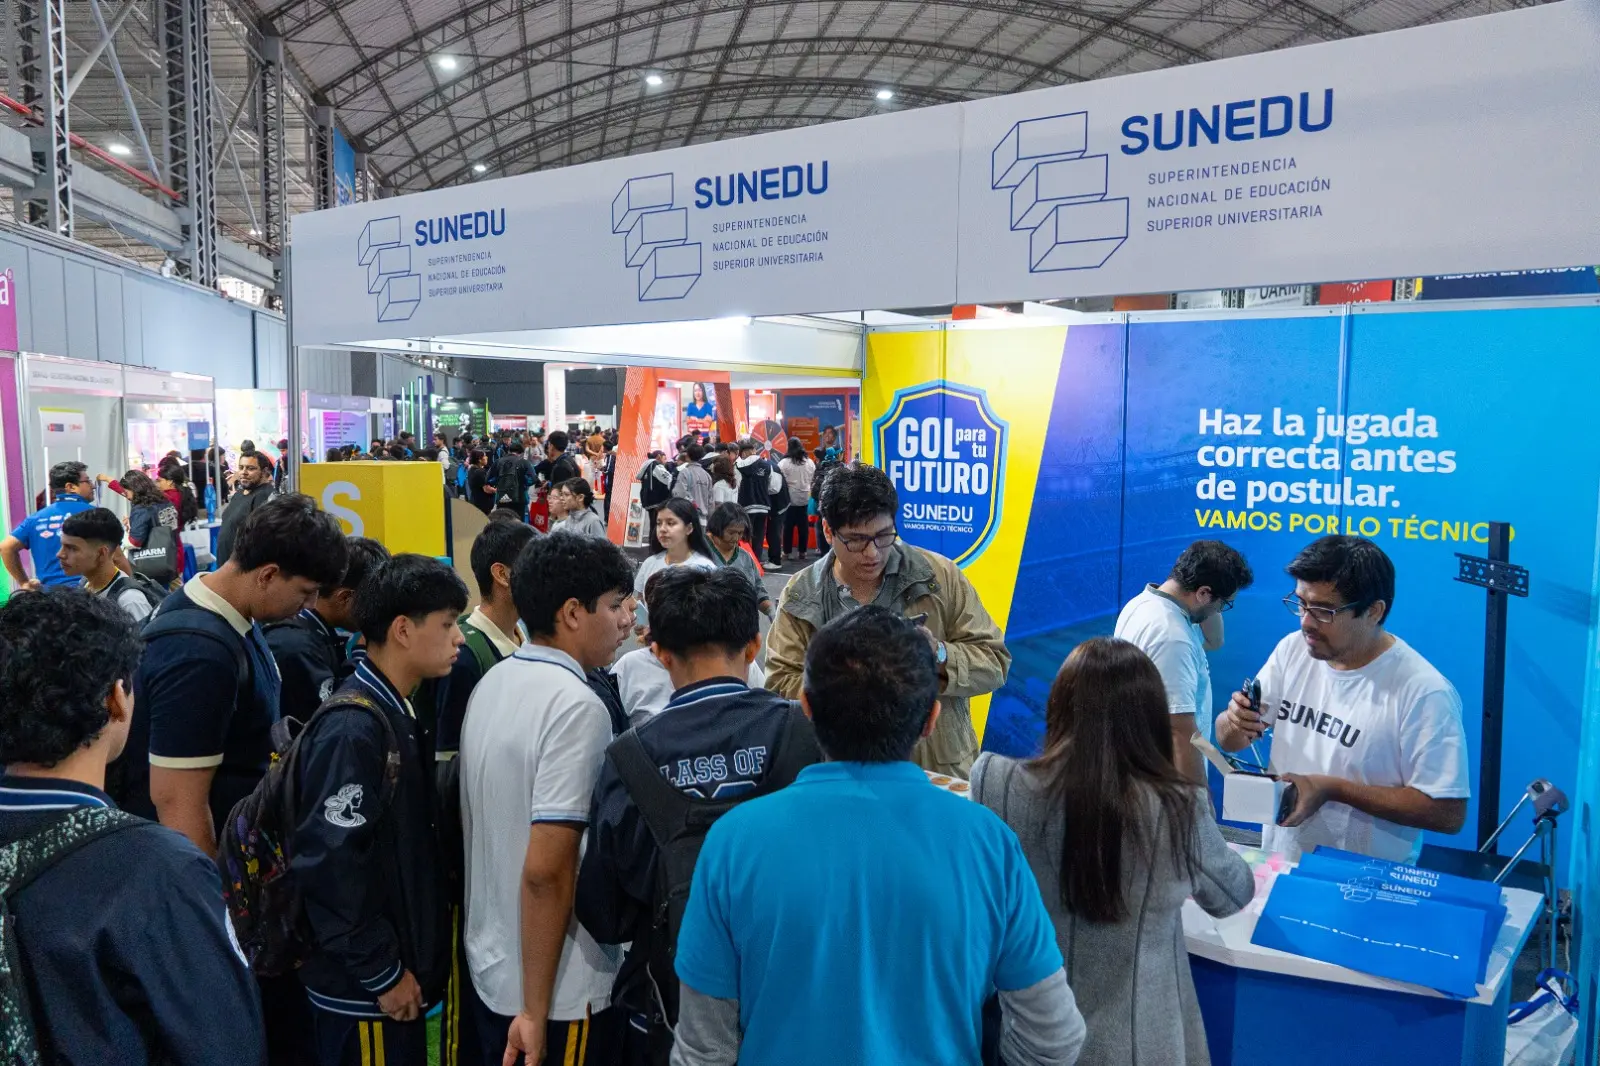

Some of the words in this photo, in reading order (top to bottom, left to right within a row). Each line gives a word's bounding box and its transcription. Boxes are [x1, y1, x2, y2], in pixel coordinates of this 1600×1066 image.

[1120, 88, 1333, 155] SUNEDU
[694, 160, 828, 209] SUNEDU
[1148, 157, 1296, 184] SUPERINTENDENCIA
[1148, 190, 1217, 208] NACIONAL
[1224, 188, 1242, 200] DE
[1250, 176, 1330, 198] EDUCACIÓN
[415, 208, 506, 246] SUNEDU
[712, 214, 808, 233] SUPERINTENDENCIA
[1147, 215, 1212, 232] SUPERIOR
[1218, 204, 1323, 226] UNIVERSITARIA
[712, 238, 758, 252] NACIONAL
[762, 236, 774, 248] DE
[778, 230, 828, 246] EDUCACIÓN
[428, 251, 492, 266] SUPERINTENDENCIA
[428, 272, 458, 281] NACIONAL
[460, 270, 469, 278] DE
[472, 264, 506, 278] EDUCACIÓN
[712, 258, 755, 270] SUPERIOR
[758, 252, 824, 267] UNIVERSITARIA
[428, 286, 457, 298] SUPERIOR
[458, 282, 504, 294] UNIVERSITARIA
[898, 417, 960, 460] GOL
[956, 428, 986, 445] para
[1198, 408, 1262, 436] Haz
[1273, 407, 1306, 436] la
[1312, 407, 1438, 444] jugada
[972, 442, 986, 458] tu
[1197, 444, 1341, 470] correcta
[1350, 445, 1457, 474] antes
[890, 460, 988, 496] FUTURO
[1196, 472, 1237, 500] de
[1246, 476, 1400, 508] postular.
[322, 480, 364, 538] S
[903, 502, 973, 522] SUNEDU
[947, 524, 974, 534] TÉCNICO
[1194, 508, 1282, 532] VAMOS
[1388, 514, 1516, 543] TÉCNIC
[1278, 700, 1361, 748] SUNEDU
[660, 754, 728, 787] LASS
[734, 746, 766, 776] OF
[1382, 884, 1431, 898] SUNEDU
[1390, 872, 1438, 888] SUNEDU
